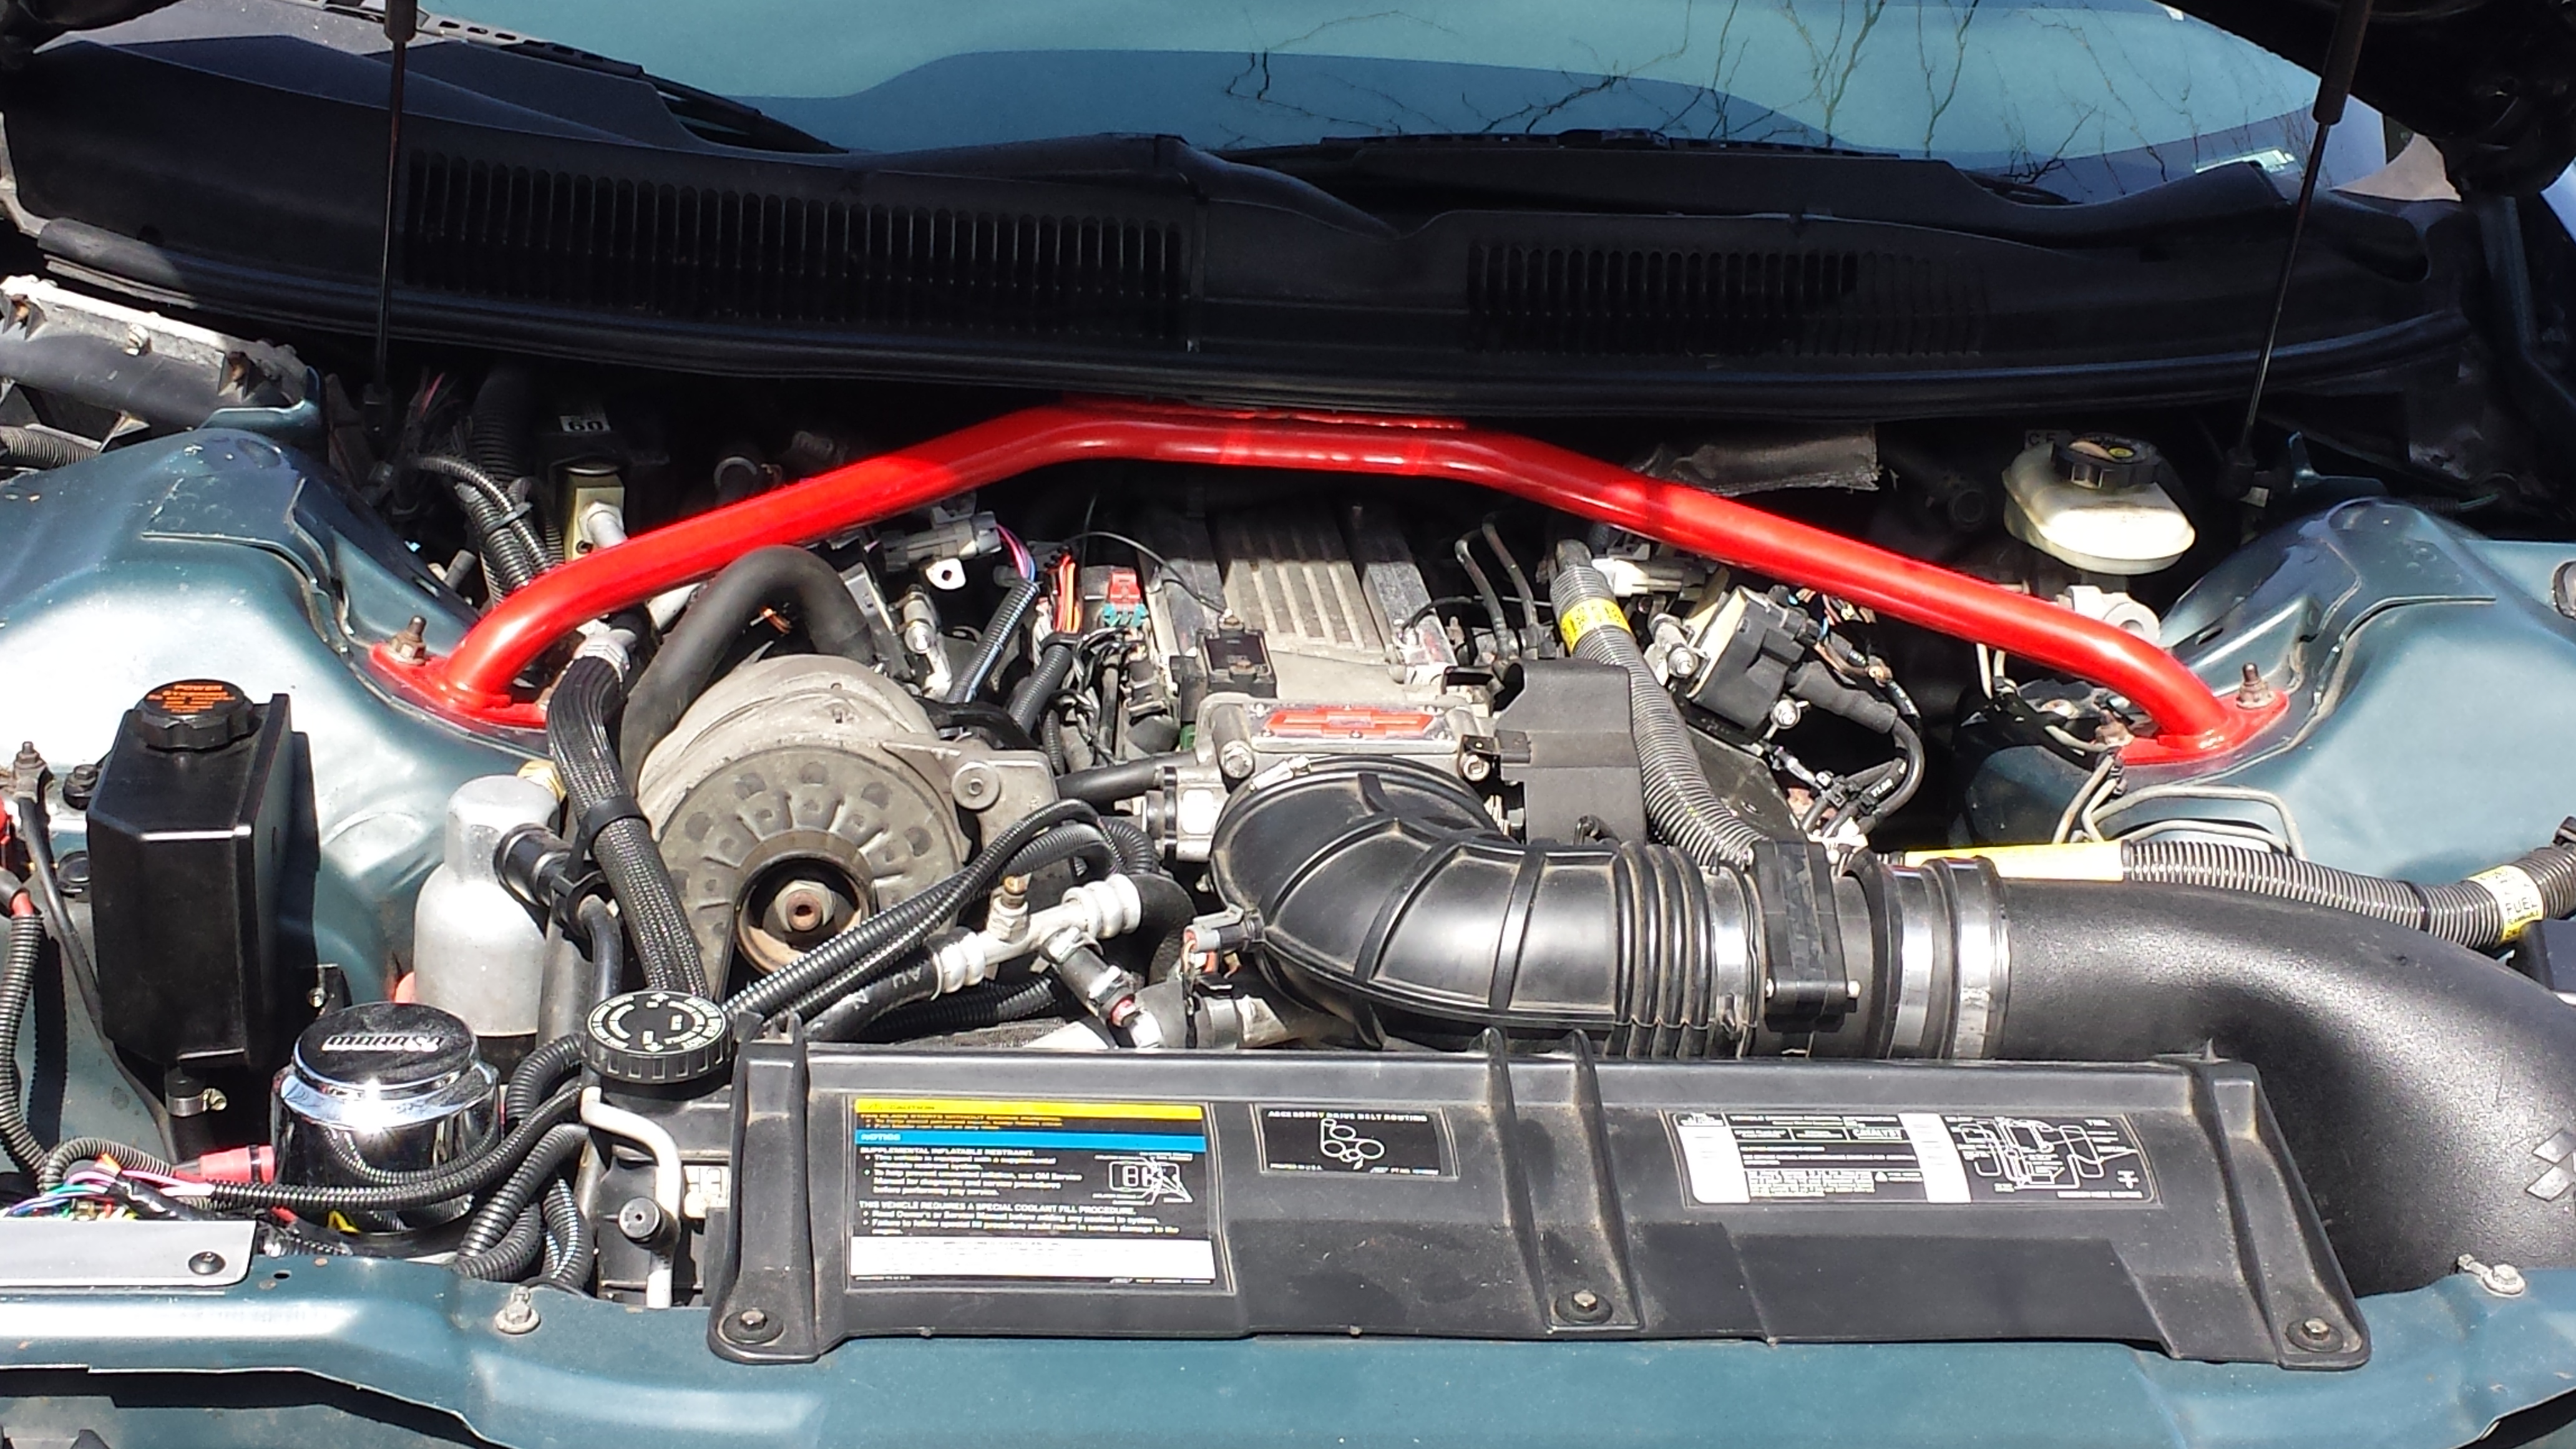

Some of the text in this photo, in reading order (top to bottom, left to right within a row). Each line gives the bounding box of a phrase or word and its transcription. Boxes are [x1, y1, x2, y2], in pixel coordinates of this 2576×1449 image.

[2505, 896, 2538, 917] FUEL
[1014, 1204, 1057, 1212] COOLANT
[1058, 1205, 1078, 1213] FILL
